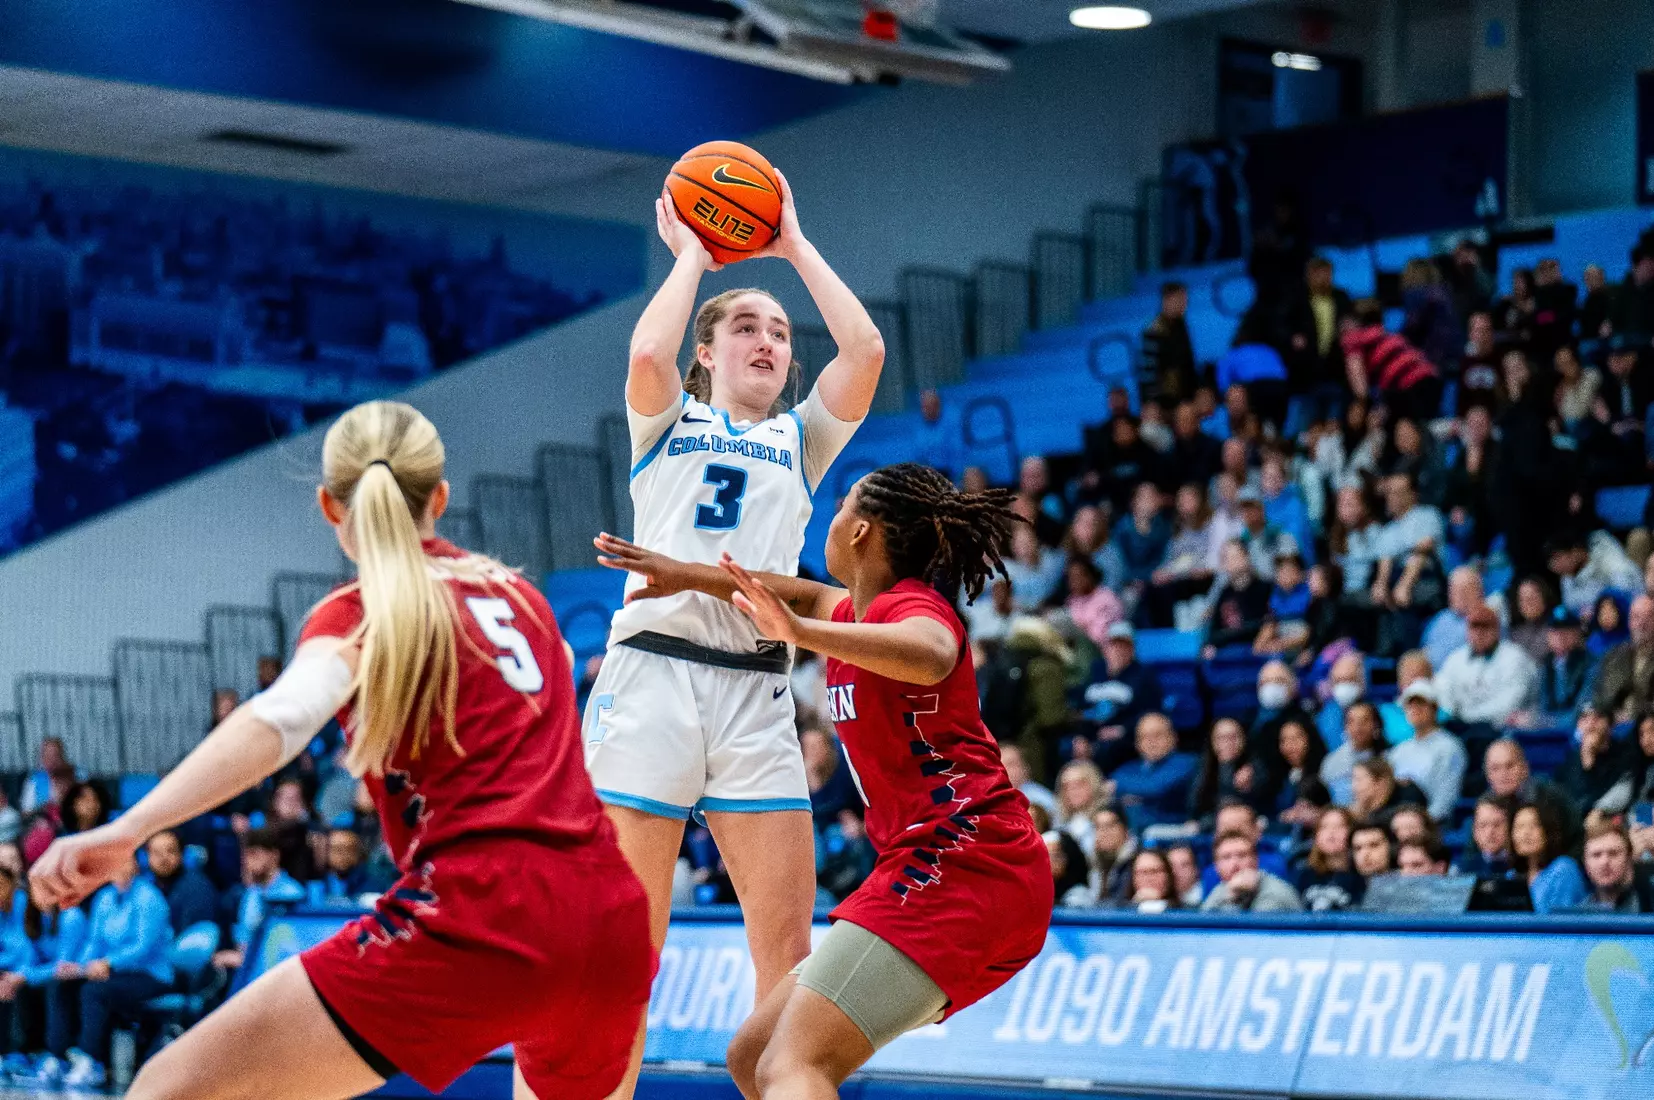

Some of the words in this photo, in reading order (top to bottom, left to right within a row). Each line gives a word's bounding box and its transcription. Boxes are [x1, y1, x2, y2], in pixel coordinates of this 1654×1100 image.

[692, 195, 757, 241] ELITE
[667, 433, 793, 471] COLUMBIA
[694, 463, 748, 531] 3
[464, 597, 544, 694] 5
[994, 952, 1150, 1046] 1090
[1142, 955, 1552, 1063] AMSTERDAM
